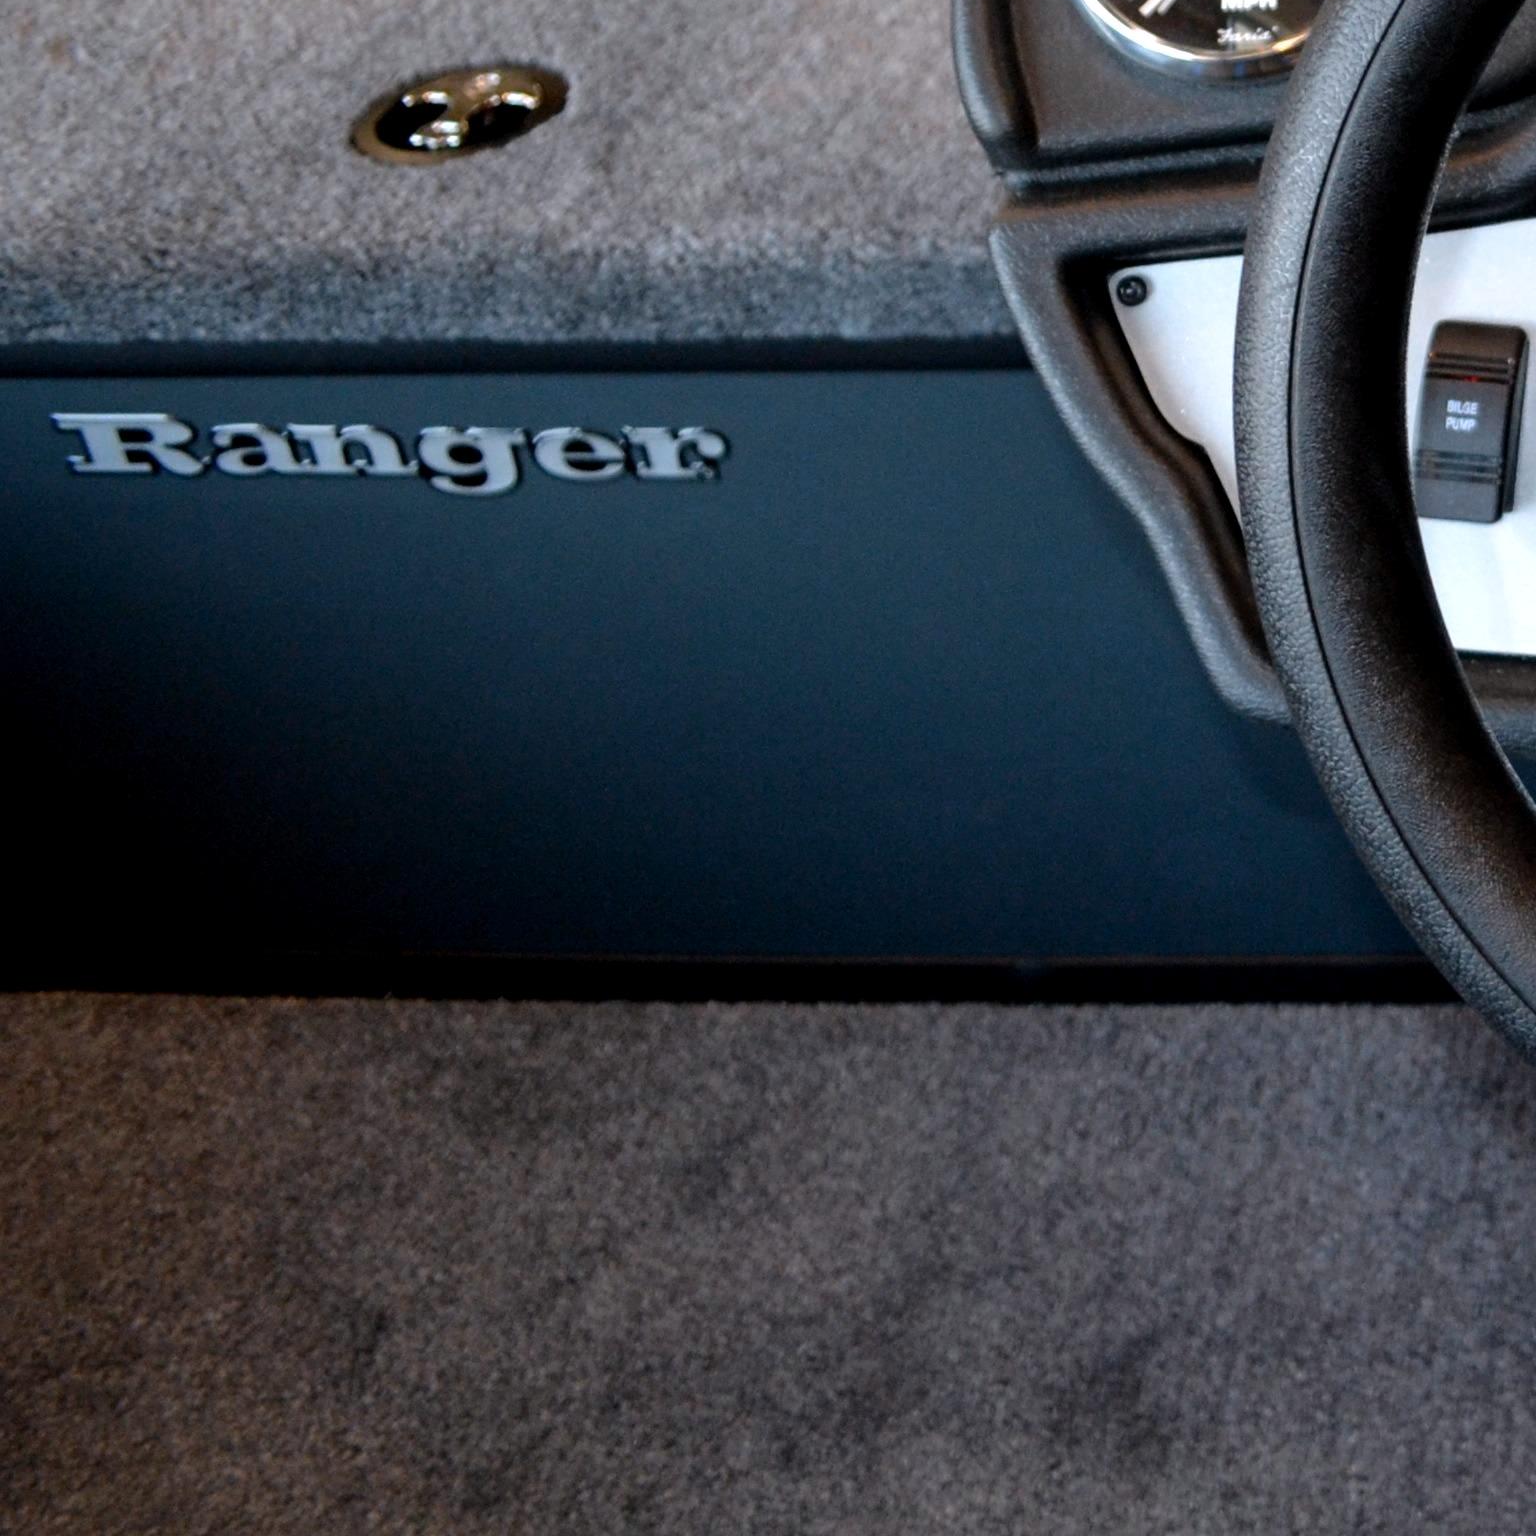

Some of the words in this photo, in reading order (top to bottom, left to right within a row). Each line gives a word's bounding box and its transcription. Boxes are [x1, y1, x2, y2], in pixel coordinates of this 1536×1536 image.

[1446, 399, 1478, 415] BILGE
[1444, 416, 1477, 431] PUMP
[50, 412, 726, 496] Ranger
